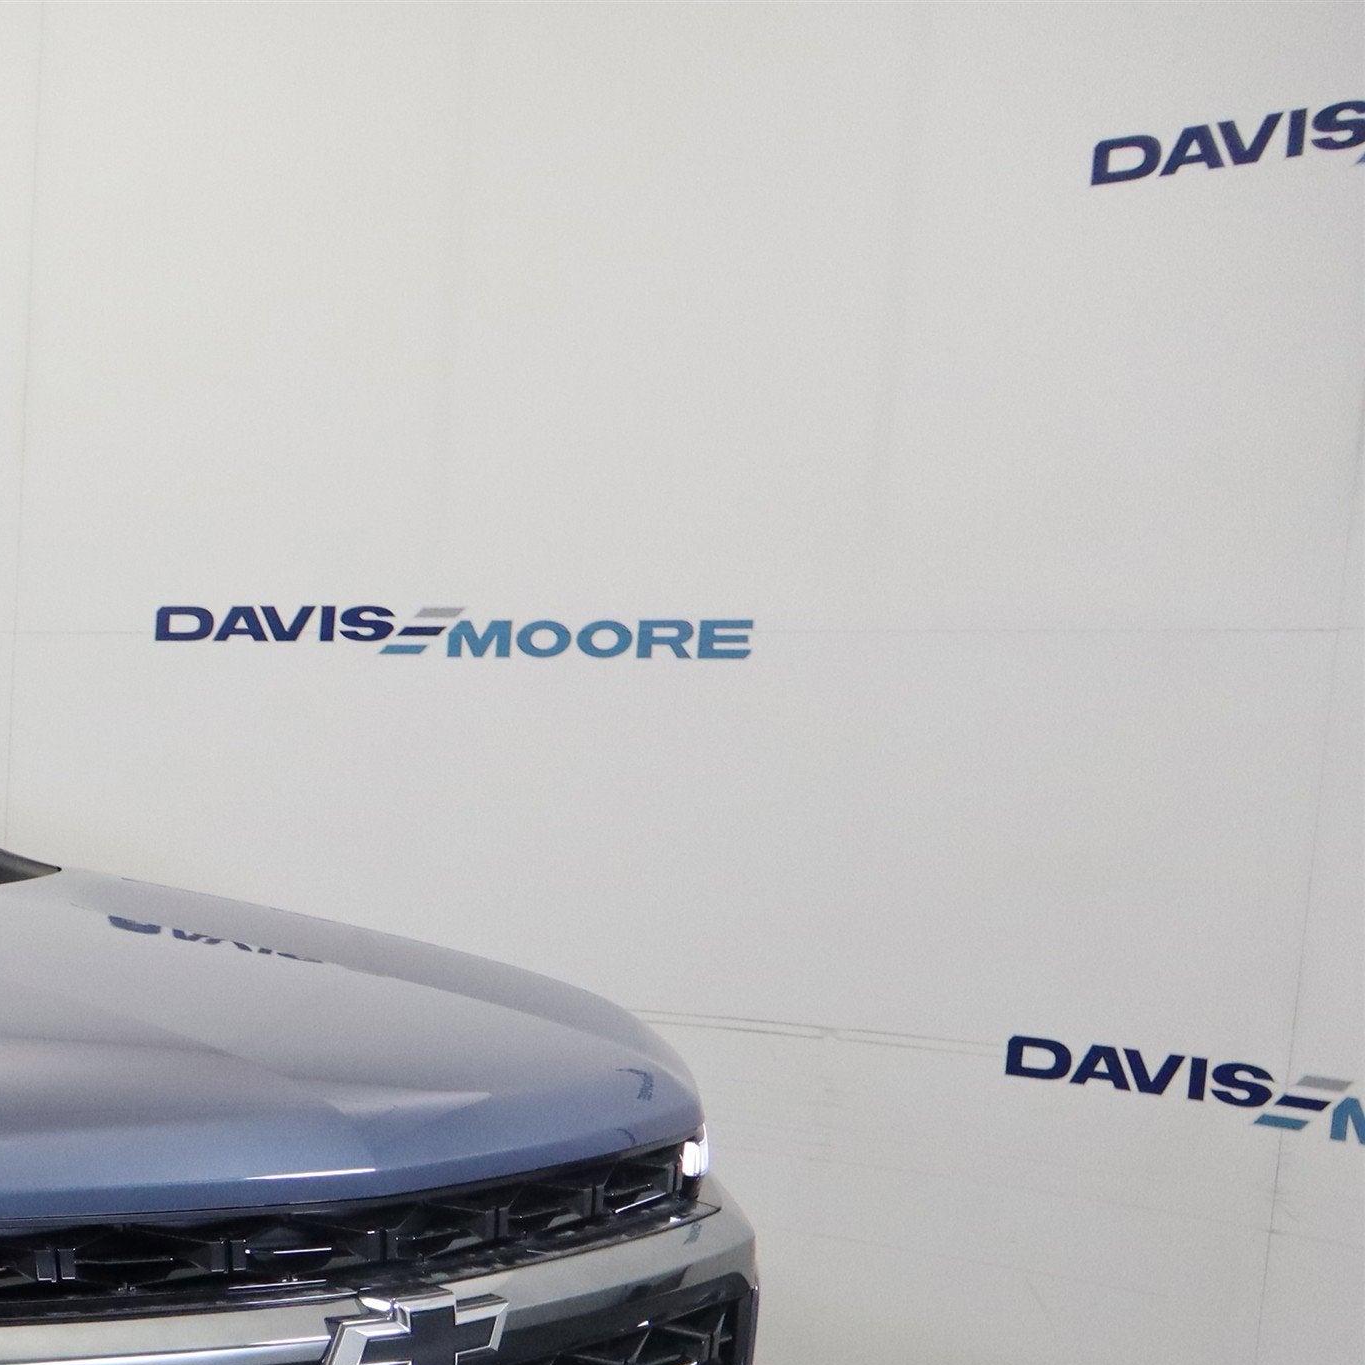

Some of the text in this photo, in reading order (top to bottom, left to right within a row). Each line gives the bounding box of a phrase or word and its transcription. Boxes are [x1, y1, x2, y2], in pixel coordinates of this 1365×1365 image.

[1090, 98, 1365, 186] DAVIS
[153, 604, 755, 661] DAVIS MOORE
[1004, 1034, 1276, 1109] DAVIS
